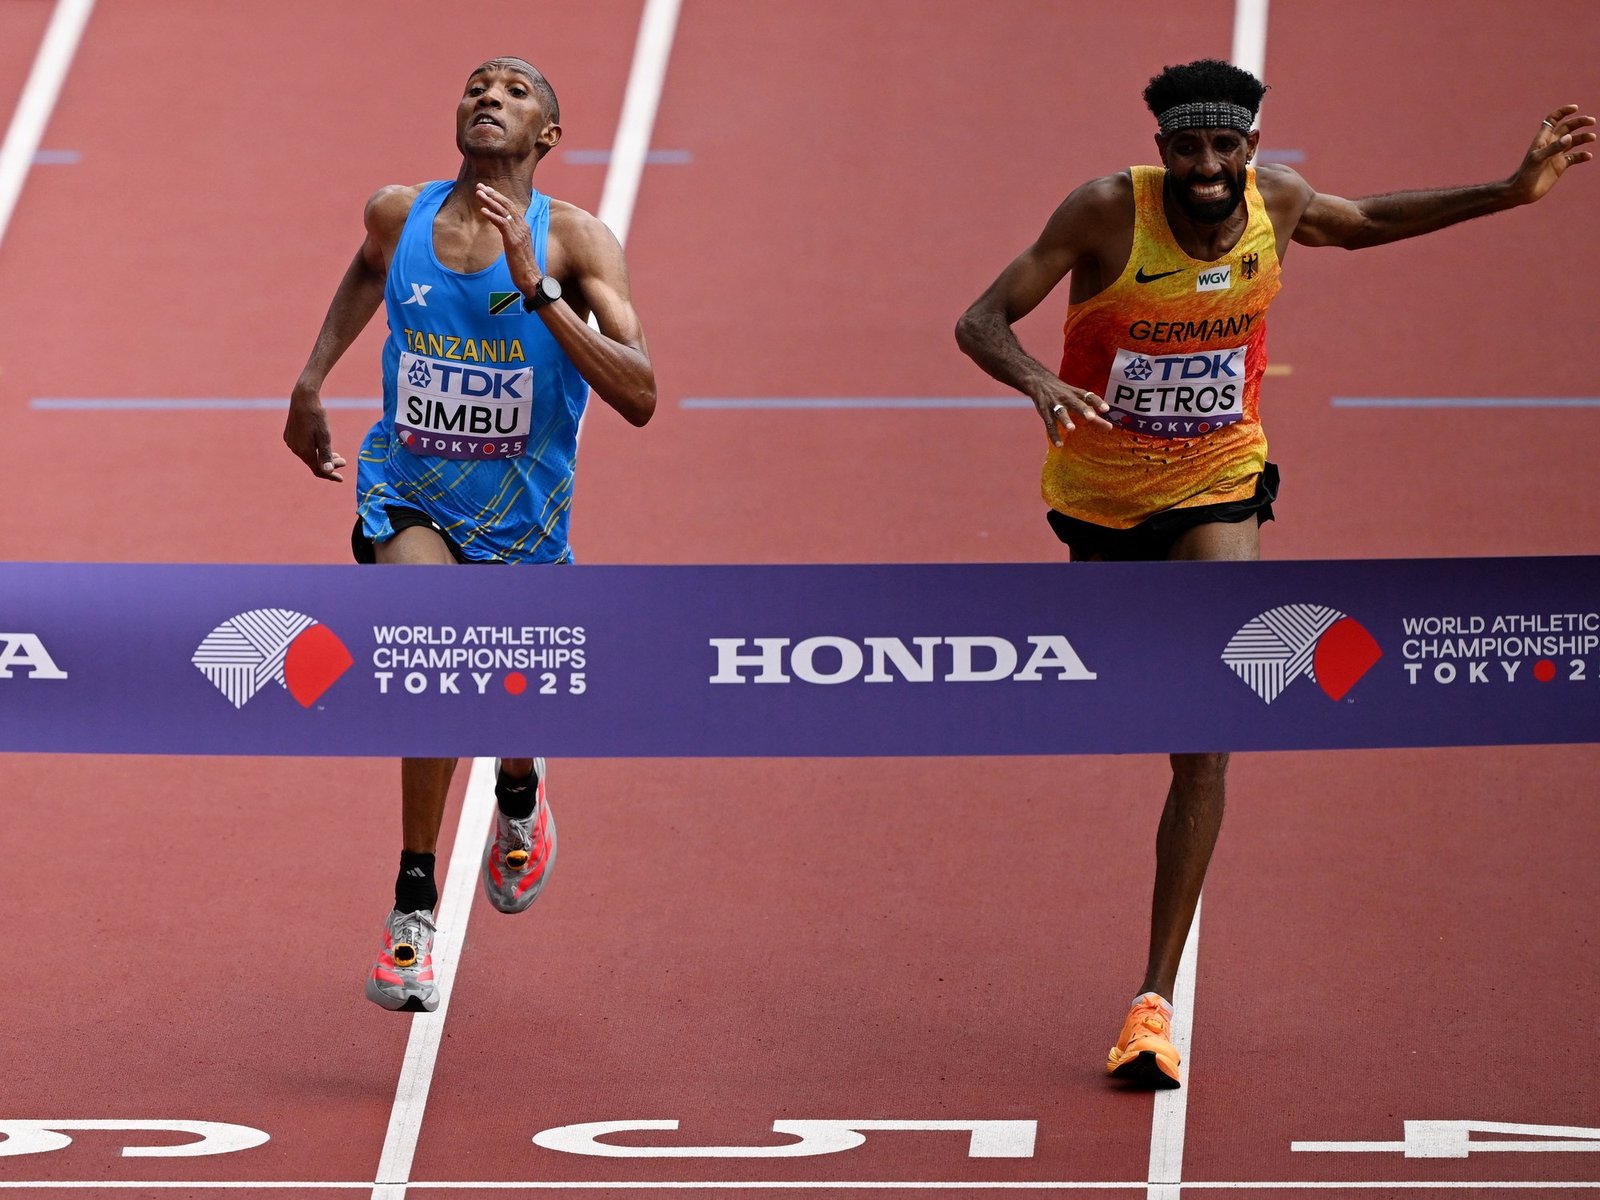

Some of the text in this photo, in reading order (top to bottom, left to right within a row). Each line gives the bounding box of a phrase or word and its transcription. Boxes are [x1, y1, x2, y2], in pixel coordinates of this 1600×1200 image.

[1199, 270, 1230, 286] WGV
[1129, 311, 1259, 342] GERMANY
[404, 328, 525, 363] TANZANIA
[1154, 352, 1238, 381] TDK
[432, 363, 524, 399] TDK
[1114, 384, 1236, 413] PETROS
[406, 396, 519, 434] SIMBU
[1215, 420, 1237, 430] 2
[373, 626, 586, 646] WORLD ATHLETICS
[1402, 616, 1485, 635] WORLD
[372, 647, 586, 669] CHAMPIONSHIPS
[709, 635, 1098, 684] HONDA
[1402, 635, 1600, 659] CHAMPIONSHIP
[1568, 659, 1600, 681] 2
